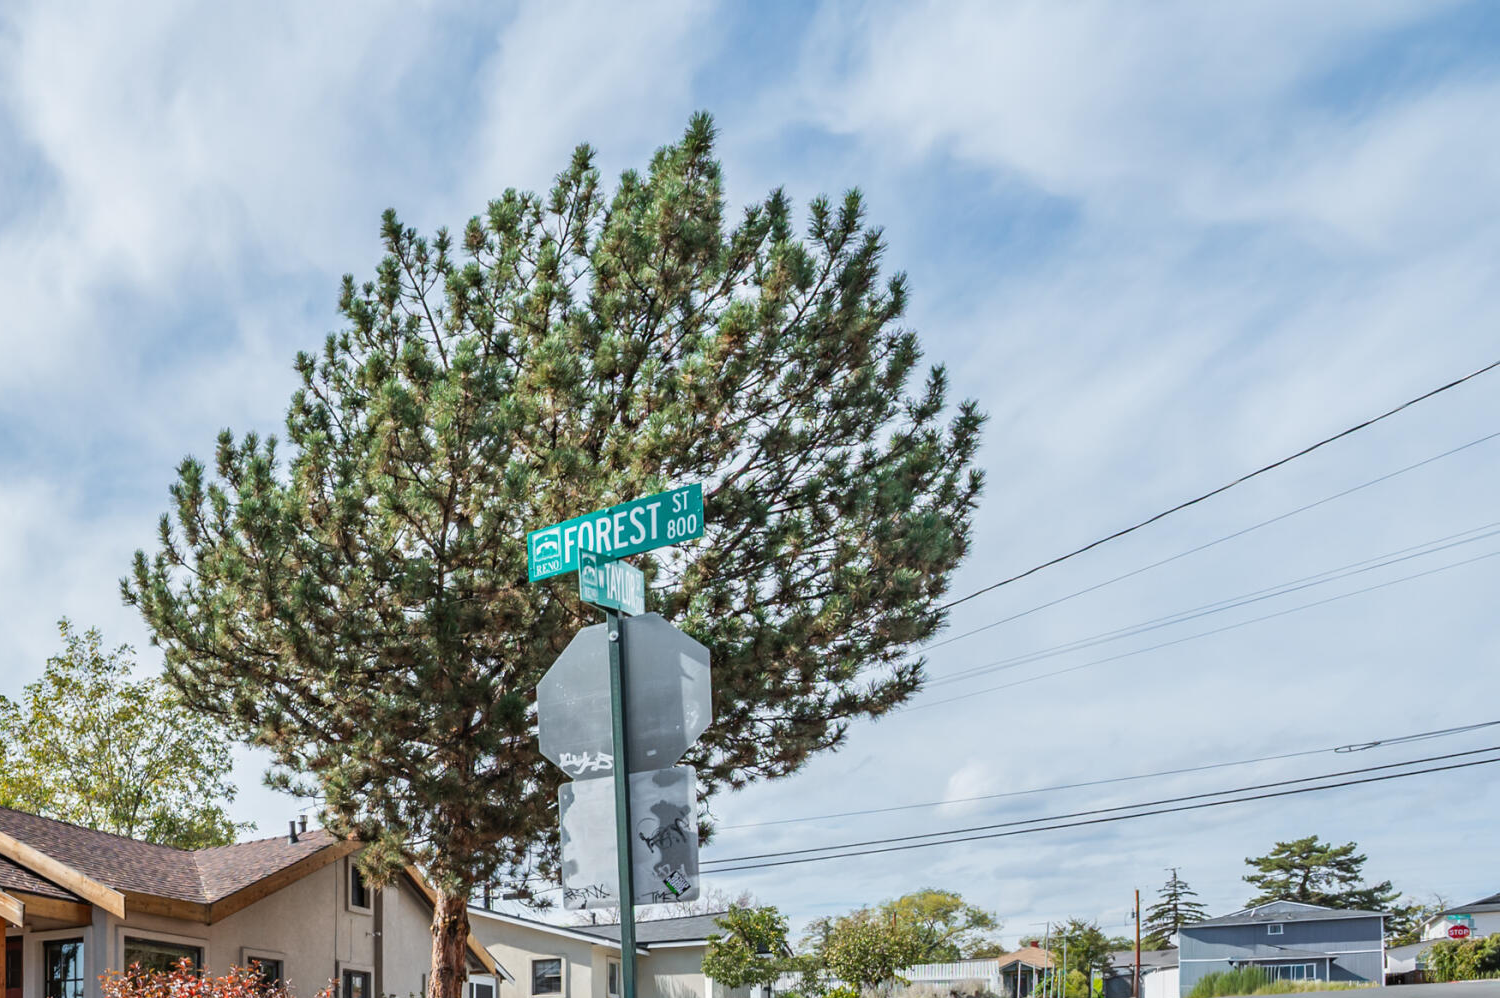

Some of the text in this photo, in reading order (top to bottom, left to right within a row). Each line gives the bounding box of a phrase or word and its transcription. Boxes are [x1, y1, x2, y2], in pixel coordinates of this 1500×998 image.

[564, 490, 690, 564] FOREST ST
[667, 513, 697, 540] 800
[536, 559, 560, 576] RENO
[604, 562, 636, 609] TAYLOR
[1449, 928, 1469, 936] STOP
